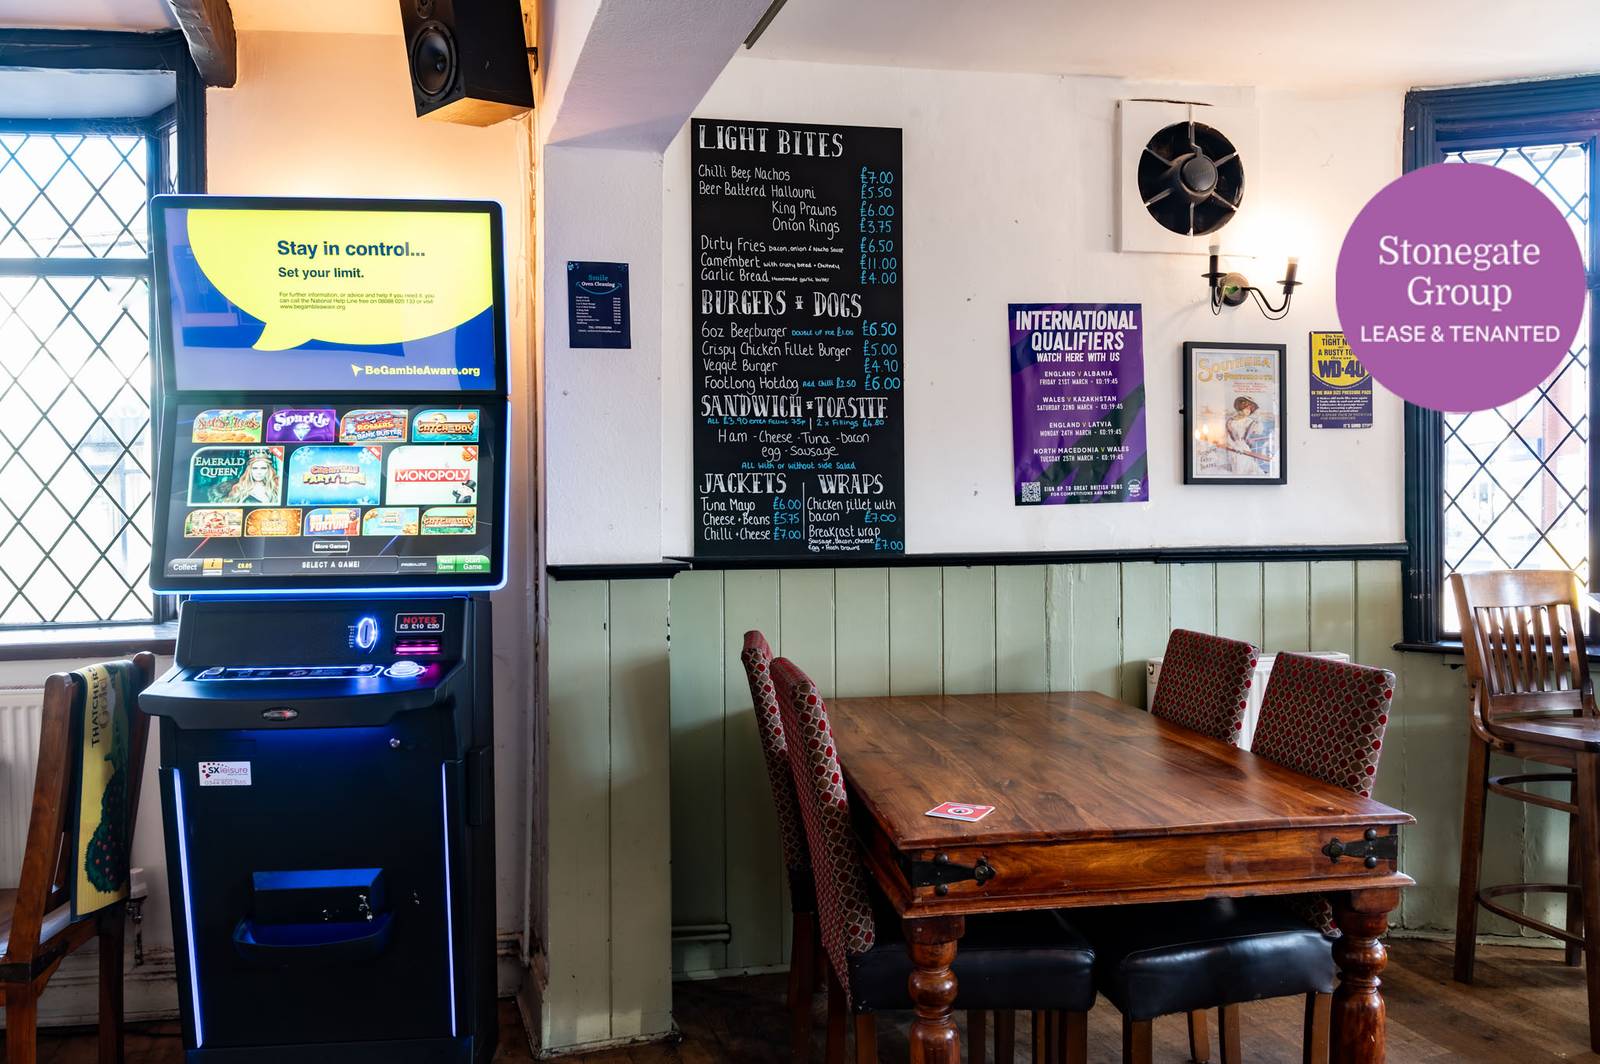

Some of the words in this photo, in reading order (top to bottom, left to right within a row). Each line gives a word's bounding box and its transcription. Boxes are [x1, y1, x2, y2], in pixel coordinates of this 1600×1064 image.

[698, 124, 769, 153] LIGHT
[776, 129, 843, 158] BITES
[698, 164, 727, 178] Chilli
[731, 164, 750, 182] Beef
[754, 168, 790, 181] Nachos
[860, 166, 894, 184] £7.00
[698, 181, 722, 195] Beer
[724, 182, 766, 198] Battered
[771, 186, 816, 199] Halloumi
[860, 184, 892, 200] £5.50
[772, 200, 796, 220] King
[800, 202, 837, 216] Prawns
[860, 201, 895, 217] £6.00
[772, 217, 805, 231] Onion
[809, 218, 840, 240] Rings
[860, 218, 892, 233] £3.75
[277, 240, 318, 260] Stay
[324, 240, 340, 257] in
[345, 241, 426, 258] control...
[700, 234, 733, 258] Dirty
[737, 237, 766, 252] Fries
[860, 236, 894, 253] £6.50
[700, 252, 760, 268] Camembert
[860, 254, 897, 270] £11.00
[278, 267, 300, 278] Set
[303, 269, 330, 282] your
[334, 267, 364, 279] limit.
[700, 268, 735, 282] Garlic
[739, 269, 770, 282] Bread
[861, 270, 897, 284] £4.00
[701, 289, 786, 316] BURGERS
[812, 292, 862, 318] DOGS
[1016, 310, 1138, 330] INTERNATIONAL
[701, 320, 725, 338] 6oz
[730, 322, 787, 344] Beefburger
[863, 320, 897, 337] £6.50
[1031, 332, 1125, 352] QUALIFIERS
[1322, 338, 1340, 346] TIGHT
[702, 340, 736, 360] Crispy
[740, 342, 781, 356] Chicken
[784, 342, 815, 356] Fillet
[818, 342, 852, 362] Burger
[864, 340, 898, 357] £5.00
[1036, 353, 1062, 363] WATCH
[1065, 352, 1084, 362] HERE
[1088, 352, 1106, 362] WITH
[1110, 352, 1120, 362] US
[365, 364, 480, 378] BeGambleAware.org
[703, 358, 737, 375] Veggie
[742, 358, 778, 375] Burger
[864, 358, 899, 374] £4.90
[1318, 360, 1365, 378] WD-40
[704, 376, 756, 394] Footlong
[760, 376, 800, 396] Hotdog
[865, 374, 901, 391] £6.00
[1040, 378, 1056, 386] FRIDAY
[700, 394, 803, 418] SANDWICH
[274, 412, 331, 432] Sparkle
[724, 416, 748, 425] £3.90
[718, 428, 748, 444] Ham
[194, 456, 246, 467] EMERALD
[761, 446, 782, 462] egg
[200, 466, 238, 478] QUEEN
[758, 462, 776, 470] with
[778, 462, 785, 470] or
[788, 462, 815, 470] without
[836, 462, 856, 470] Salad
[396, 470, 469, 481] MONOPOLY
[700, 472, 787, 494] JACKETS
[817, 474, 884, 494] WRAPS
[700, 496, 726, 512] Tuna
[730, 498, 756, 518] Mayo
[772, 496, 802, 511] £6.00
[806, 496, 843, 510] Chicken
[845, 498, 872, 514] fillet
[874, 499, 896, 510] with
[702, 512, 736, 526] Cheese
[742, 513, 770, 526] Beans
[772, 512, 800, 526] £5.75
[808, 511, 840, 522] bacon
[864, 511, 896, 523] £7.00
[704, 527, 732, 541] Chilli
[740, 527, 771, 541] Cheese
[773, 526, 802, 541] £7.00
[808, 524, 856, 540] Breakfast
[858, 528, 880, 540] wrap
[874, 538, 904, 550] £7.00
[172, 562, 198, 574] Collect
[403, 616, 438, 624] NOTES
[208, 766, 220, 774] SX
